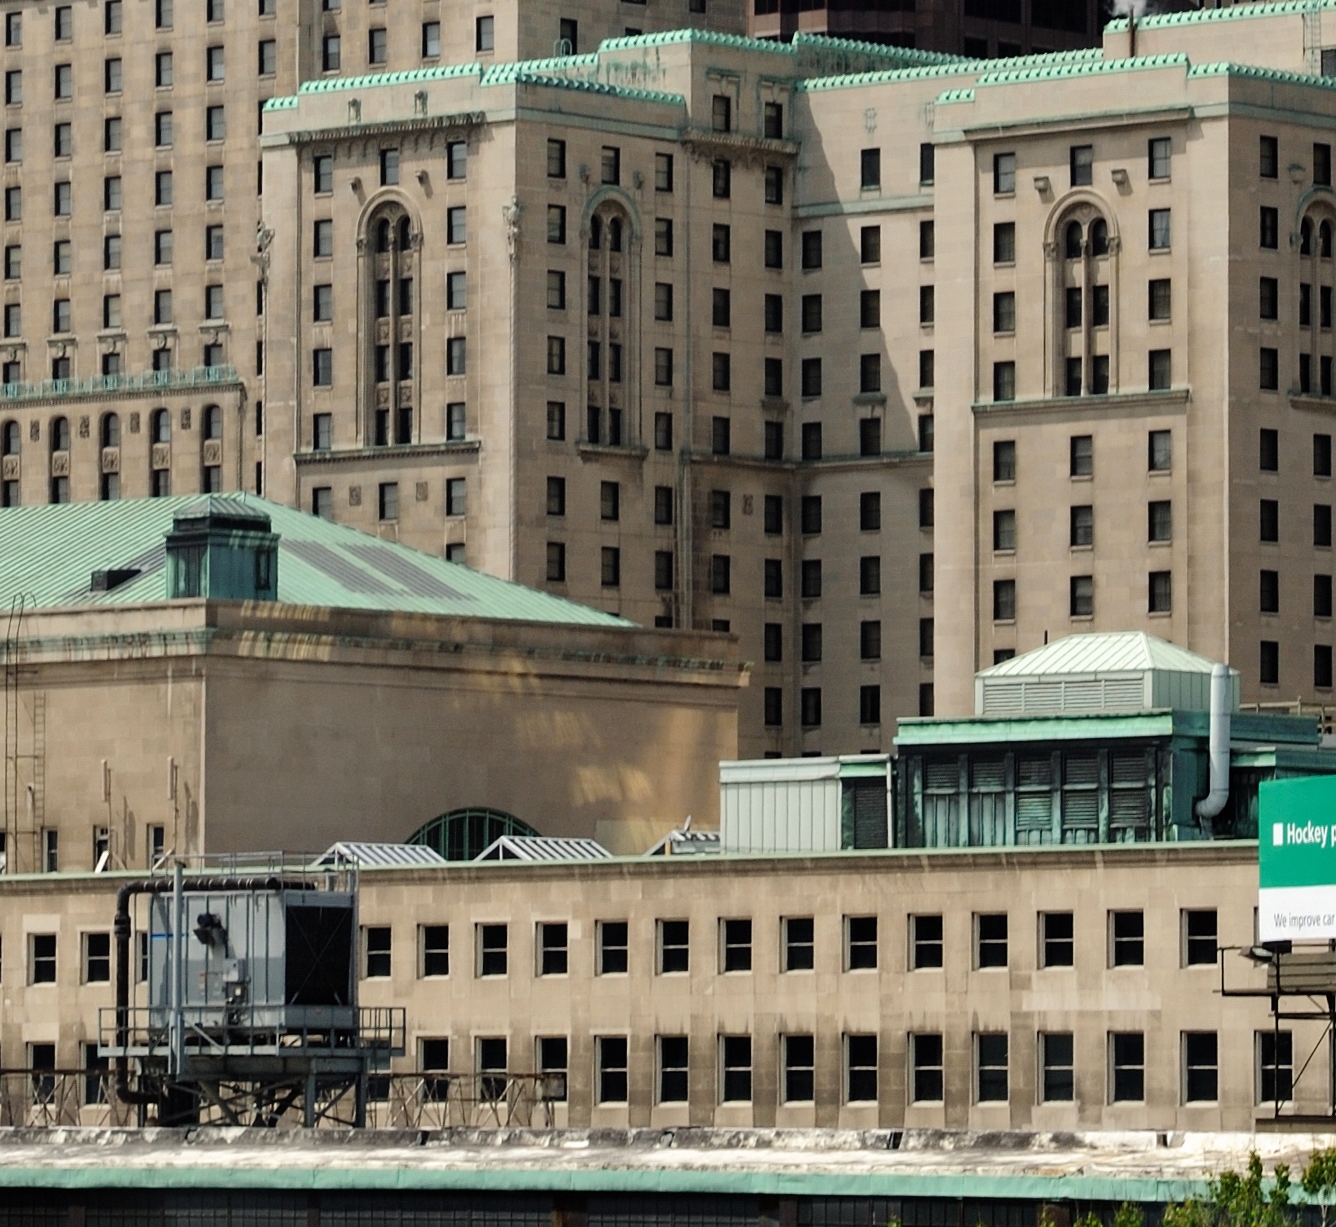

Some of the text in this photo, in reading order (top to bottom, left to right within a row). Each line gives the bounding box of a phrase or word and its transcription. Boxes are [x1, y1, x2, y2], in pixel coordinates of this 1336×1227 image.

[1287, 819, 1328, 849] Hockey
[1274, 913, 1287, 927] We
[1289, 912, 1321, 931] improve
[1323, 913, 1335, 926] car
